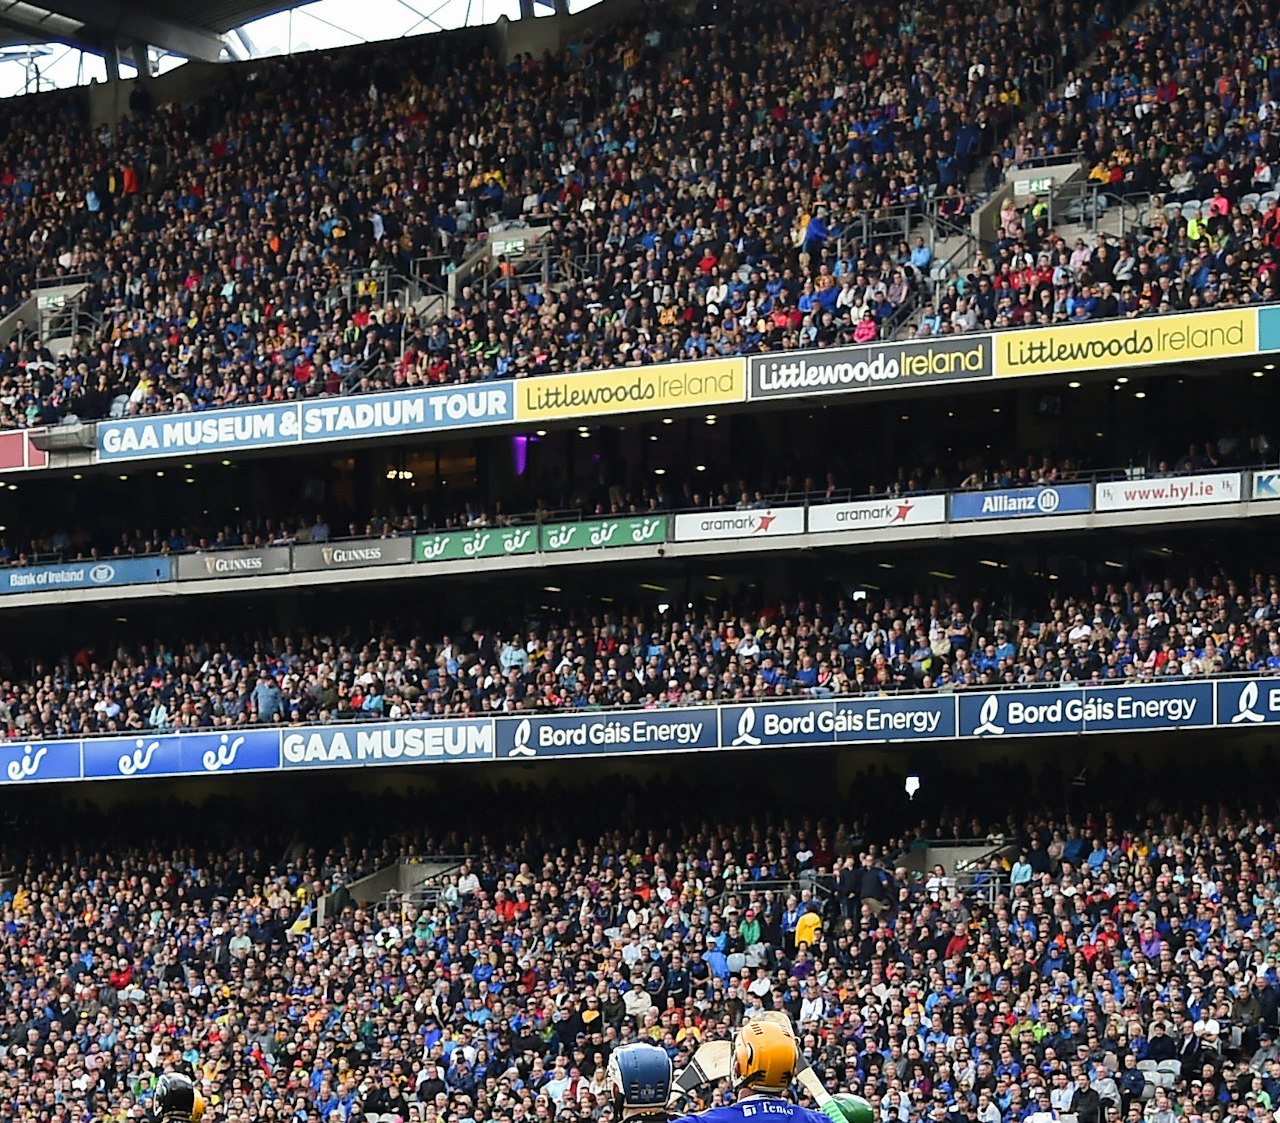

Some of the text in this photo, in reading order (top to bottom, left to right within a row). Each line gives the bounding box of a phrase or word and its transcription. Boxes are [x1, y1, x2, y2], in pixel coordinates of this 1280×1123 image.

[102, 389, 507, 453] GAA MUSEUM & STADIUM TOUR
[1124, 483, 1214, 501] www.hyl.ie
[835, 505, 893, 523] aramark
[982, 495, 1035, 513] Allianz
[591, 522, 618, 545] eir
[632, 519, 660, 542] eir
[700, 515, 756, 532] aramark
[424, 536, 450, 559] eir
[464, 532, 490, 555] eir
[504, 529, 531, 551] eir
[549, 526, 576, 548] eir
[215, 557, 262, 573] GUINNESS
[333, 548, 381, 564] GUINNESS
[10, 569, 84, 587] Bank of Ireland
[1008, 695, 1197, 725] Bord Gáis Energy
[539, 719, 703, 748] Bord Gáis Energy
[763, 708, 941, 736] Bord Gáis Energy
[203, 733, 245, 771] eir
[283, 723, 492, 763] GAA MUSEUM
[8, 745, 47, 781] eir
[119, 739, 159, 775] eir
